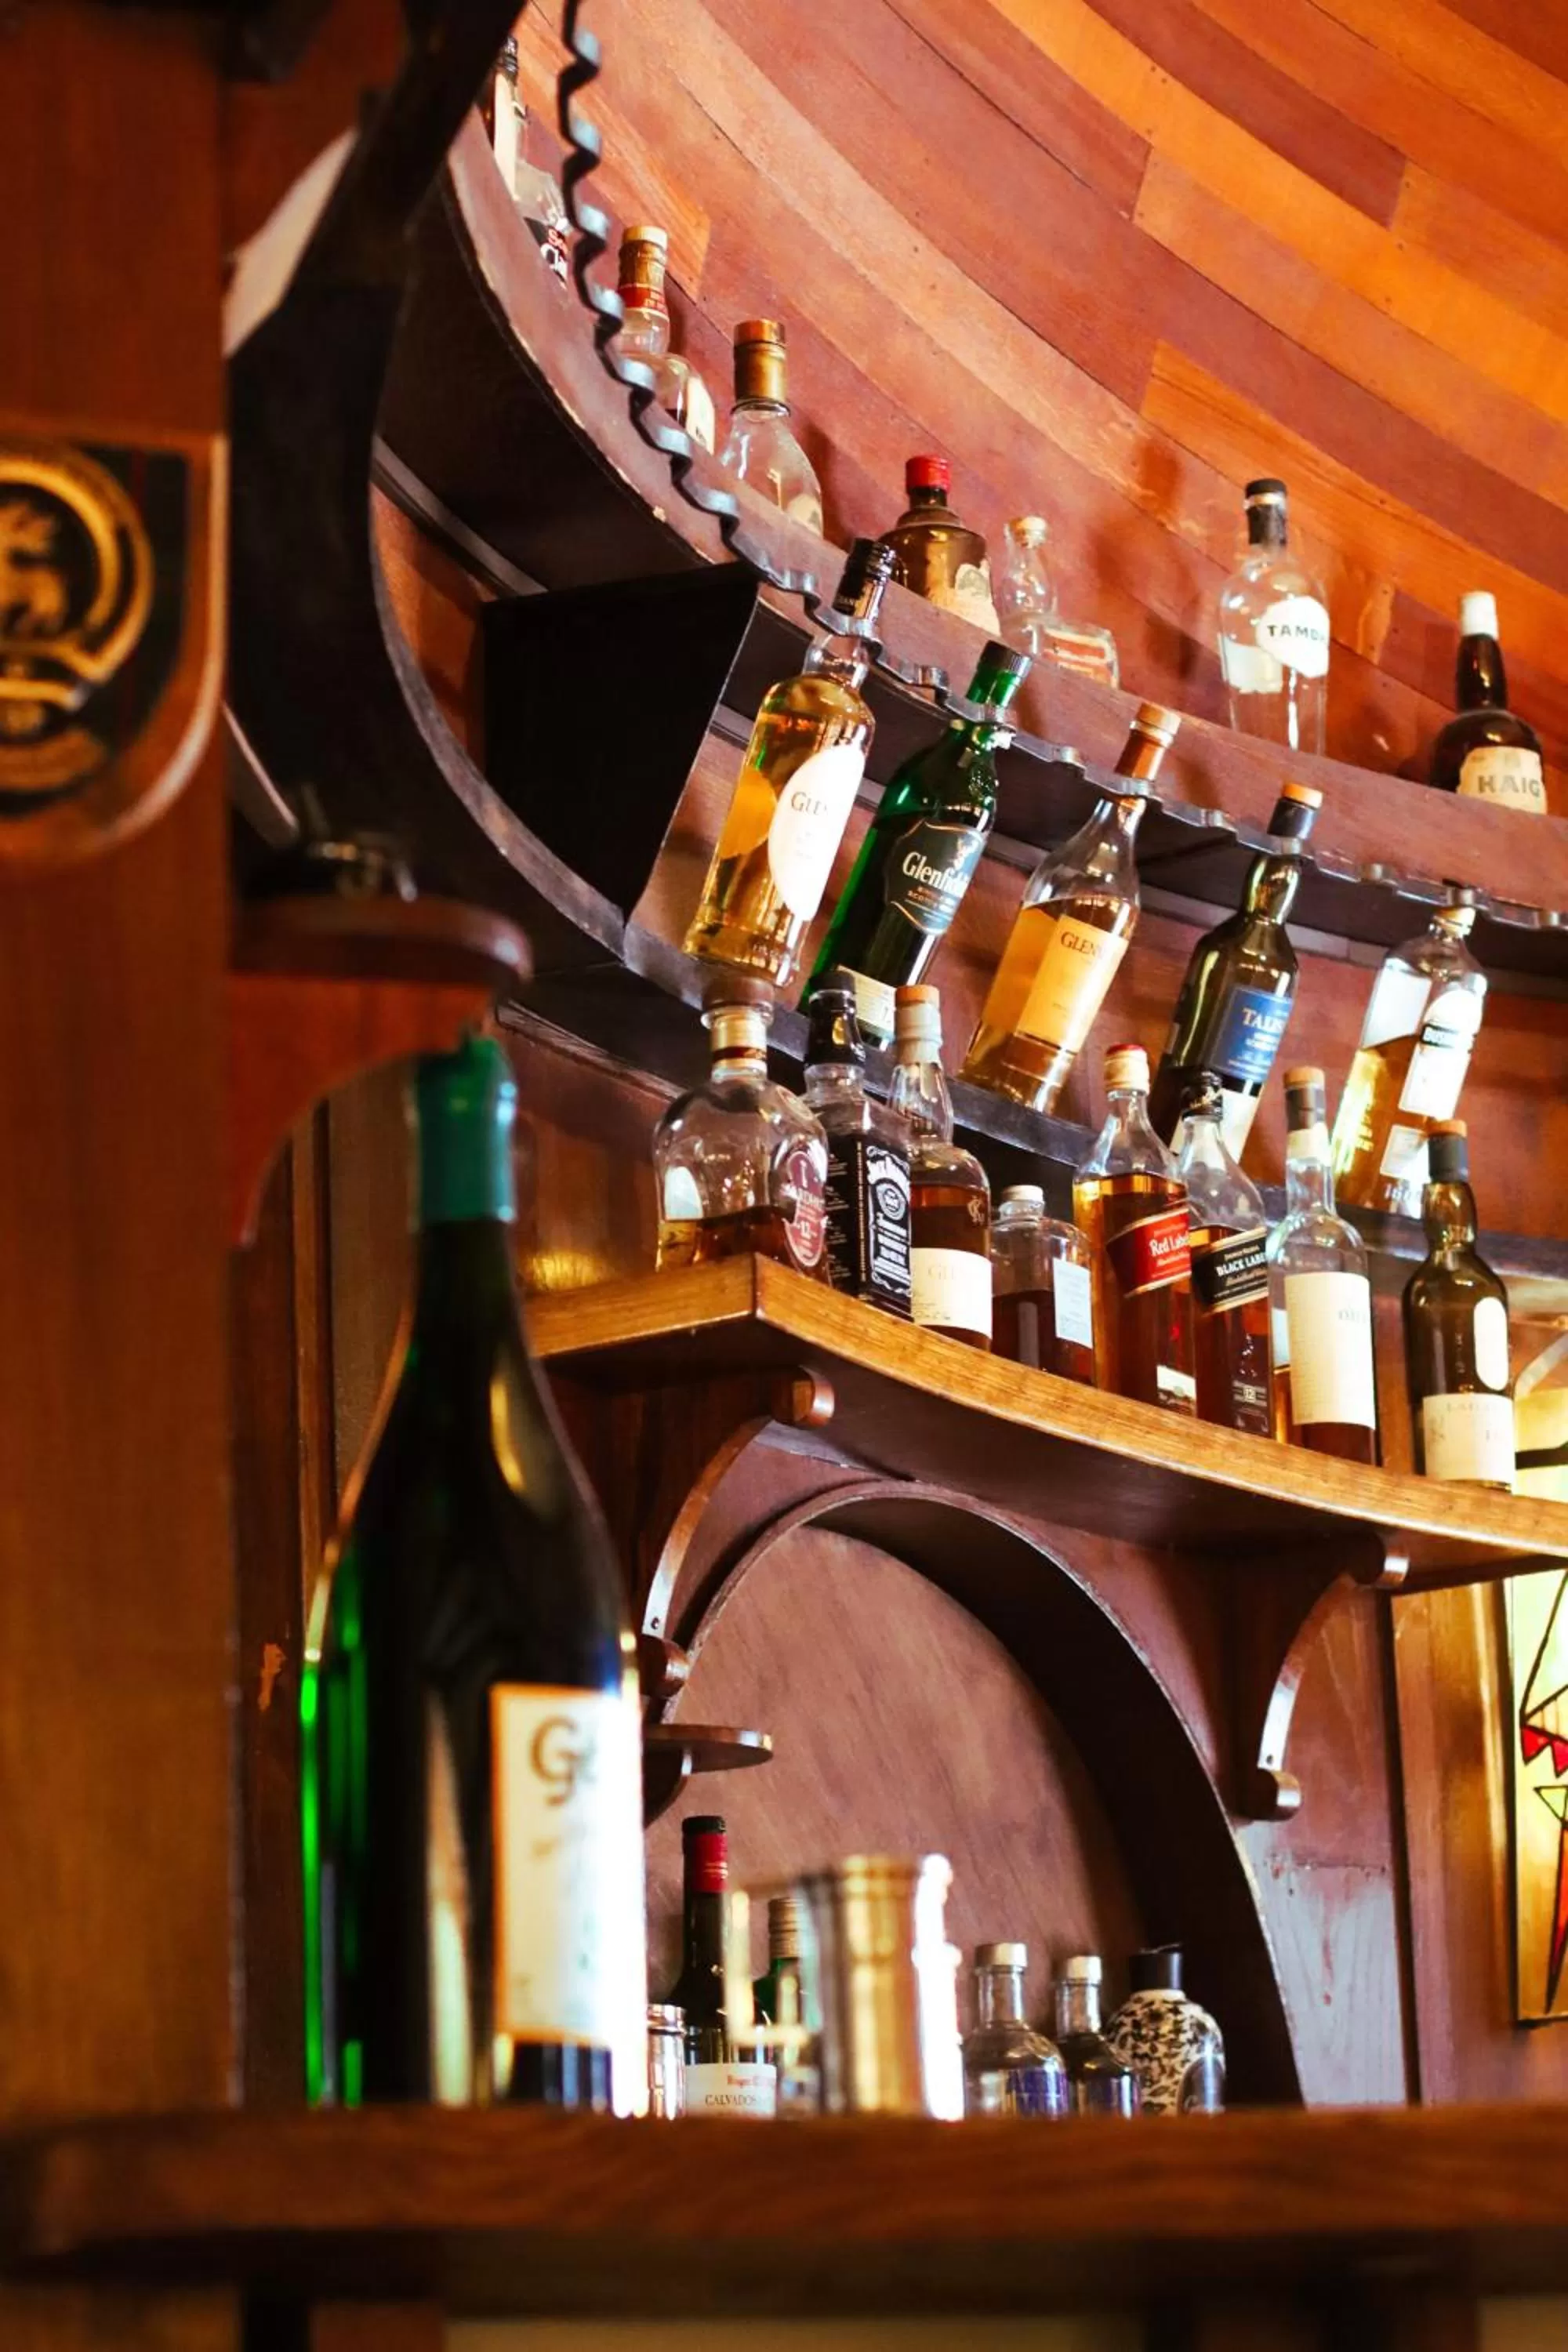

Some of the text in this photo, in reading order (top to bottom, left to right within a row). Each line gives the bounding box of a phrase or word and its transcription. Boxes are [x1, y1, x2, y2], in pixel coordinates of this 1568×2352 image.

[1478, 775, 1541, 798] HAIG
[1149, 1236, 1170, 1258] Red
[1215, 1256, 1245, 1277] BLACK
[705, 2093, 757, 2107] CALVADOS
